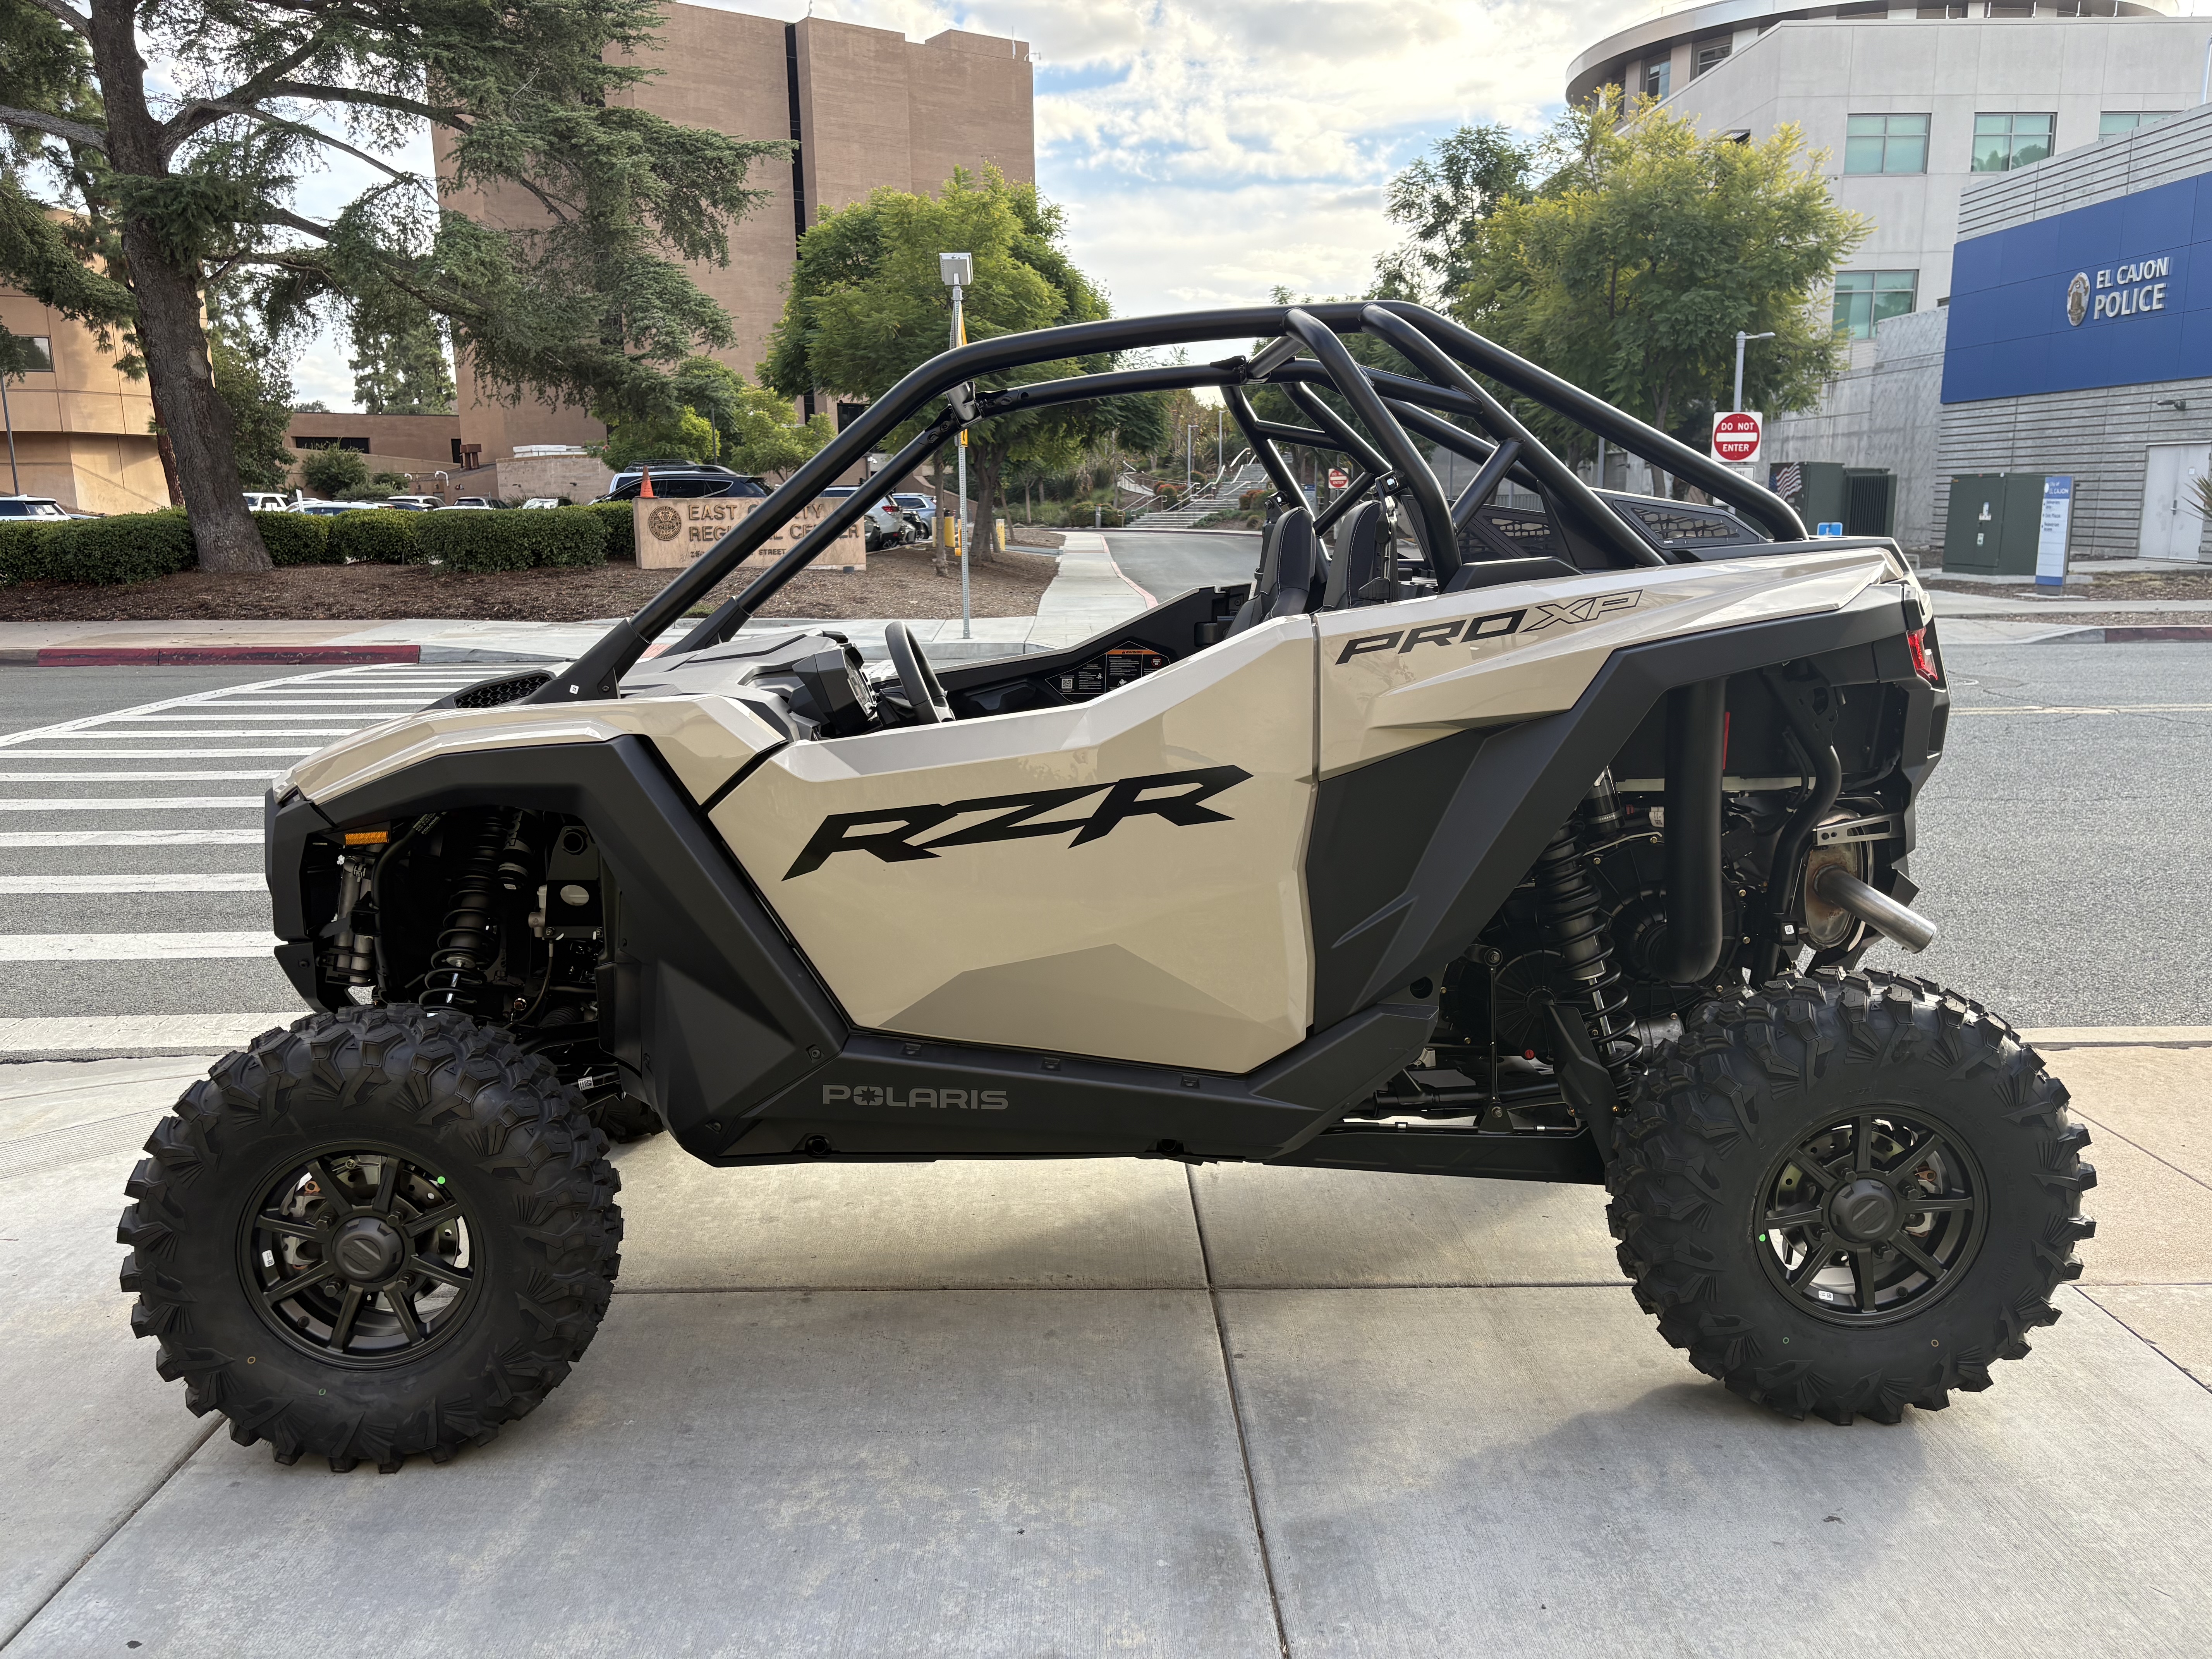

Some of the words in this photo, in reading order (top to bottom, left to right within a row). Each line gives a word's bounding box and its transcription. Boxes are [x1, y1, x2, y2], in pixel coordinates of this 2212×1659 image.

[2096, 270, 2113, 289] EL
[2117, 257, 2169, 285] CAJON
[2094, 283, 2167, 319] POLICE
[1721, 422, 1733, 431] DO
[1738, 422, 1754, 431] NOT
[1723, 443, 1749, 452] ENTER
[689, 505, 737, 520] EAST
[1335, 608, 1528, 665] PRO
[1519, 589, 1644, 633] XP
[781, 764, 1254, 881] RZR
[823, 1084, 1008, 1110] POLARIS
